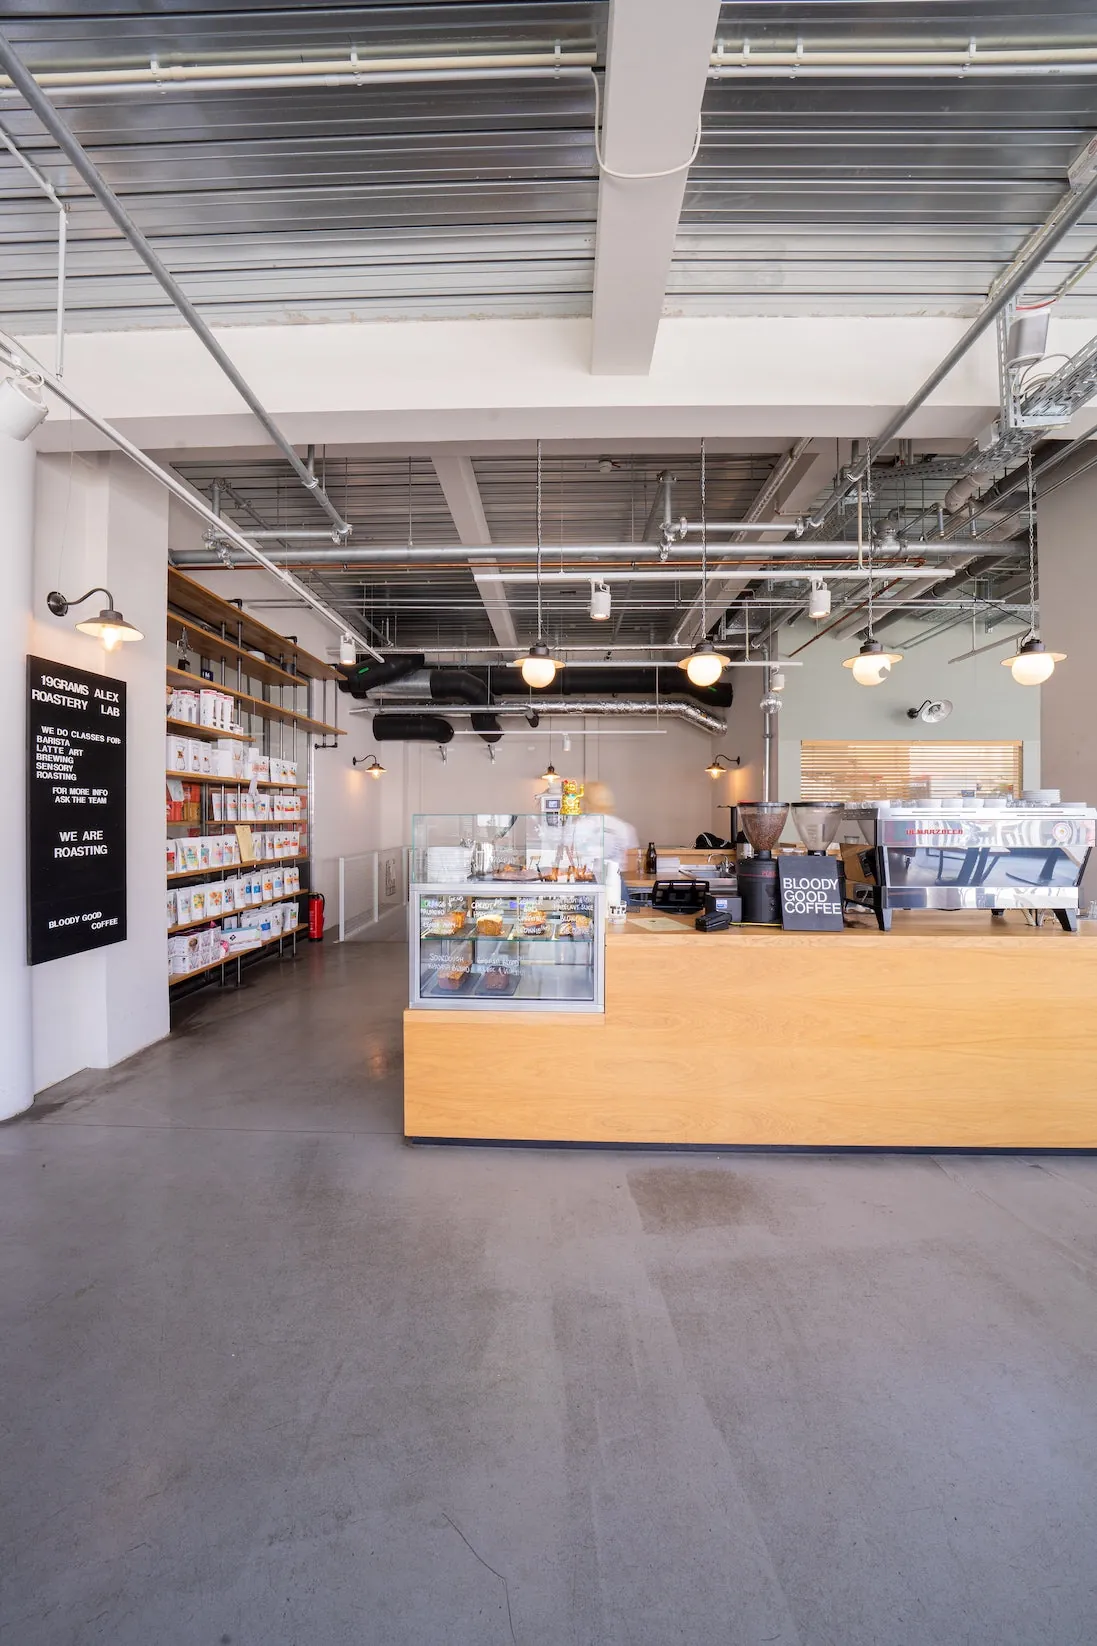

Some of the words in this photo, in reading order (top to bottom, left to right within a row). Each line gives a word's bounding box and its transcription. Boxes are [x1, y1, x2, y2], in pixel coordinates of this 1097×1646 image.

[41, 675, 89, 695] 19GRAMS
[94, 689, 119, 702] ALEX
[32, 689, 88, 710] ROASTERY
[101, 705, 120, 717] LAB
[37, 735, 70, 746] BARISTA
[41, 726, 54, 734] WE
[57, 728, 68, 736] DO
[71, 731, 105, 742] CLASSES
[37, 744, 64, 754] LATTE
[69, 748, 84, 756] ART
[36, 753, 74, 764] BREWING
[36, 762, 73, 772] SENSORY
[36, 771, 77, 781] ROASTING
[59, 831, 78, 842] WE
[82, 830, 104, 841] ARE
[54, 845, 108, 858] ROASTING
[783, 877, 839, 890] BLOODY
[784, 889, 828, 903] GOOD
[784, 901, 842, 914] COFFEE
[48, 916, 80, 929] BLOODY
[82, 911, 102, 922] GOOD
[91, 918, 119, 930] COFFEE
